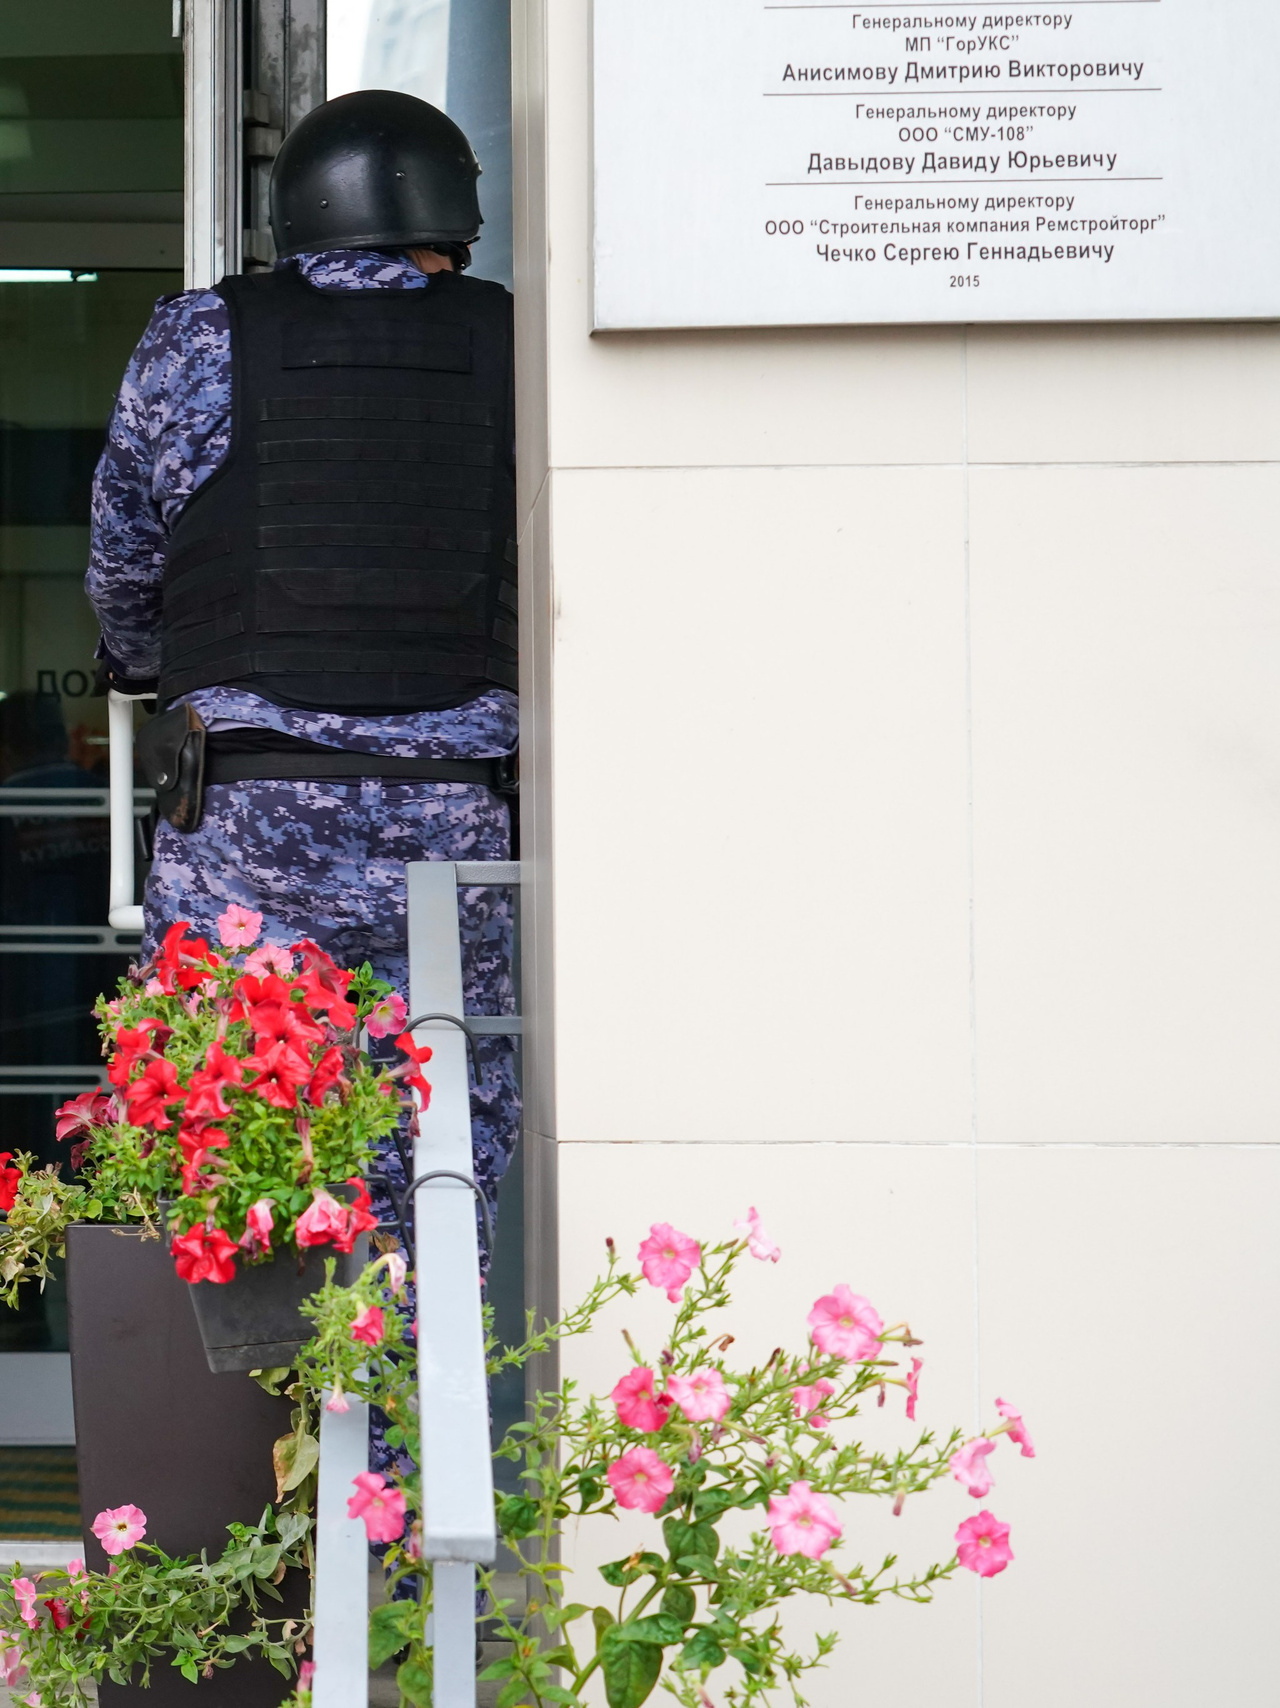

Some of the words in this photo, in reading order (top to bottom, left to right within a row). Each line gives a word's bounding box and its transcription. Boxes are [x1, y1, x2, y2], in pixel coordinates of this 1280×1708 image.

[853, 14, 976, 32] Генеральному
[982, 14, 1072, 30] директору
[906, 37, 930, 52] МП
[782, 64, 898, 84] Анисимову
[905, 62, 1000, 83] Дмитрию
[1009, 60, 1144, 81] Викторовичу
[856, 104, 980, 122] Генеральному
[986, 106, 1076, 121] директору
[899, 127, 938, 142] ООО
[808, 153, 915, 174] Давыдову
[922, 152, 1000, 174] Давиду
[1008, 151, 1117, 173] Юрьевичу
[855, 195, 979, 213] Генеральному
[984, 196, 1074, 212] директору
[765, 220, 804, 235] ООО
[947, 221, 1029, 232] компания
[817, 244, 876, 262] Чечко
[884, 243, 959, 265] Сергею
[968, 242, 1114, 263] Геннадьевичу
[950, 275, 980, 288] 2015
